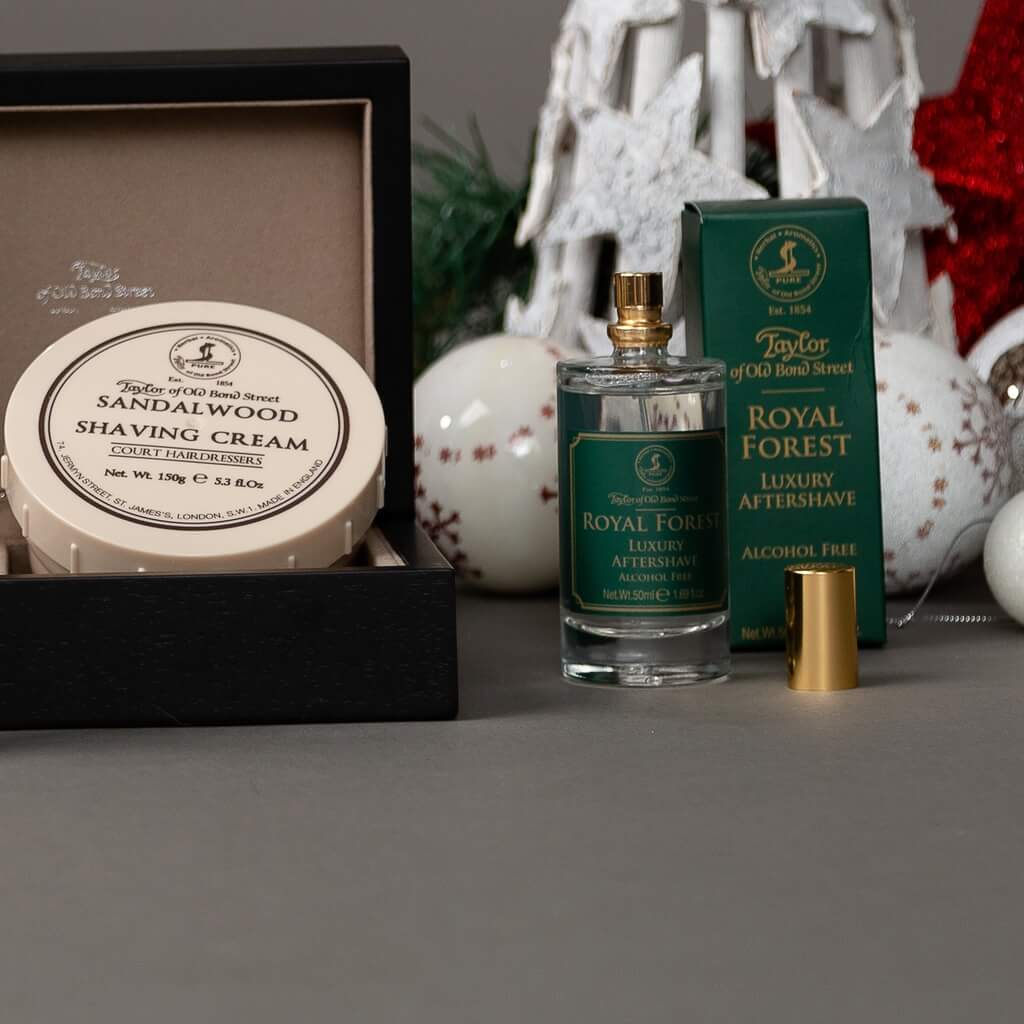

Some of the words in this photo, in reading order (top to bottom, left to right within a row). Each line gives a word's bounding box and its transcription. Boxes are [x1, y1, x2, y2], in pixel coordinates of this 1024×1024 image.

[755, 326, 830, 361] Taylor
[730, 362, 745, 384] of
[746, 362, 771, 378] Old
[776, 360, 810, 377] Bond
[813, 360, 853, 376] Street
[116, 379, 167, 396] Taylor
[168, 387, 184, 398] of
[183, 386, 207, 397] Old
[209, 389, 241, 400] Bond
[242, 392, 280, 403] Street
[97, 395, 299, 423] SANDALWOOD
[748, 405, 844, 430] ROYAL
[75, 420, 200, 442] SHAVING
[211, 431, 309, 451] CREAM
[111, 446, 162, 457] COURT
[165, 449, 263, 465] HAIRDRESSERS
[742, 434, 851, 460] FOREST
[61, 455, 83, 480] JERMYN
[257, 493, 284, 510] MADE
[283, 486, 294, 496] IN
[292, 459, 323, 490] ENGLAND
[104, 468, 128, 478] Net.
[133, 470, 153, 480] Wt.
[157, 472, 186, 485] 150g
[214, 476, 231, 486] 5.3
[760, 472, 834, 490] LUXURY
[738, 491, 857, 510] AFTERSHAVE
[583, 512, 648, 532] ROYAL
[655, 512, 720, 532] FOREST
[629, 539, 684, 552] LUXURY
[742, 544, 816, 560] ALCOHOL
[822, 543, 857, 557] FREE
[618, 573, 668, 582] ALCOHOL
